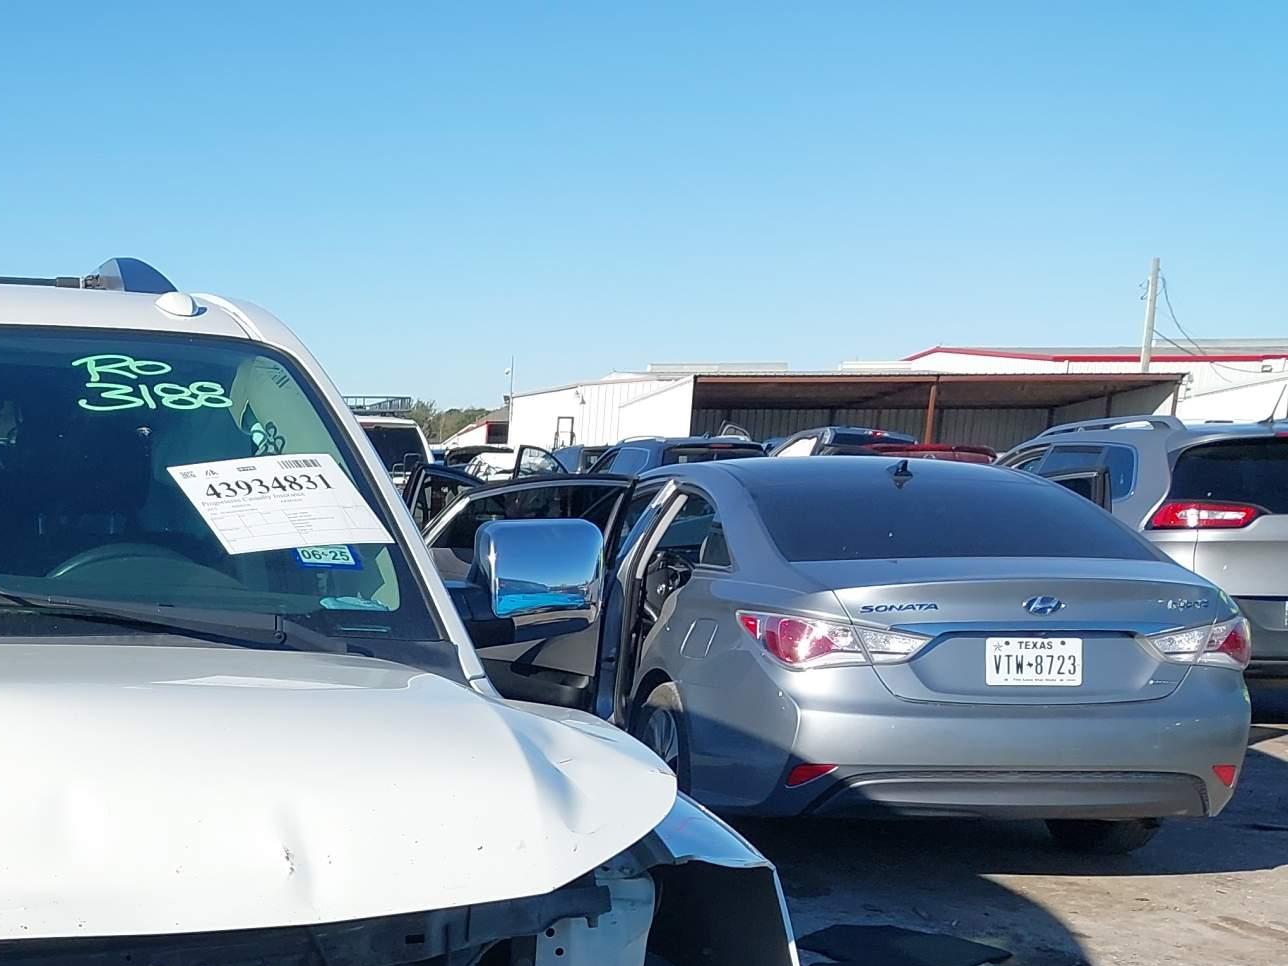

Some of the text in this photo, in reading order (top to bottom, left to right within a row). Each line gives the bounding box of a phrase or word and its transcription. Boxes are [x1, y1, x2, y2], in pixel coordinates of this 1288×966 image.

[78, 381, 233, 411] 3188
[205, 473, 335, 499] 43934831
[860, 602, 939, 614] SONATA
[1018, 640, 1053, 650] TEXAS
